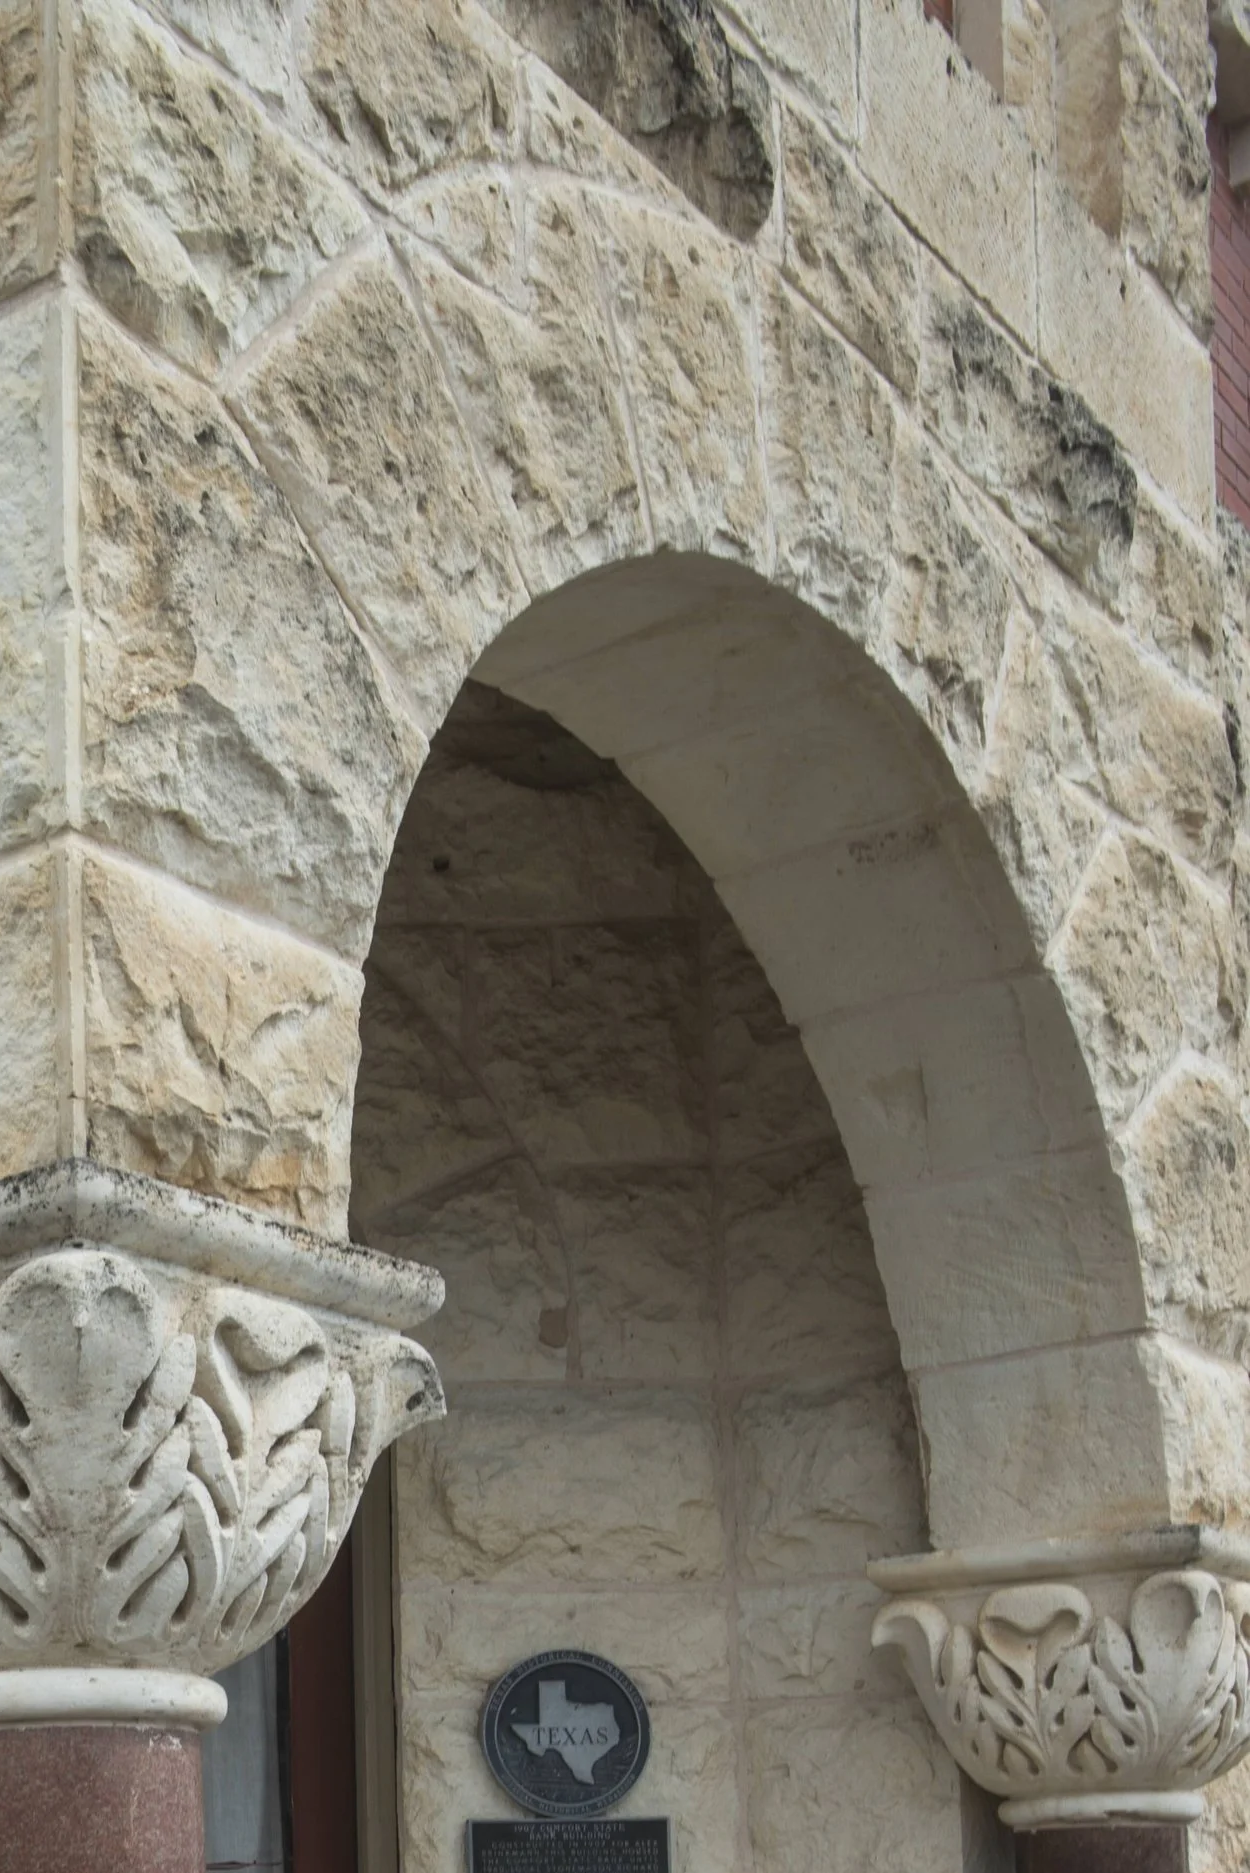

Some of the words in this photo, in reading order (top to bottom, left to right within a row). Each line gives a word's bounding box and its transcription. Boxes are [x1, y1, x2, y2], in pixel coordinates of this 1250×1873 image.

[531, 1726, 610, 1747] TEXAS
[540, 1823, 587, 1832] COMFORT
[562, 1831, 611, 1840] BUILDING
